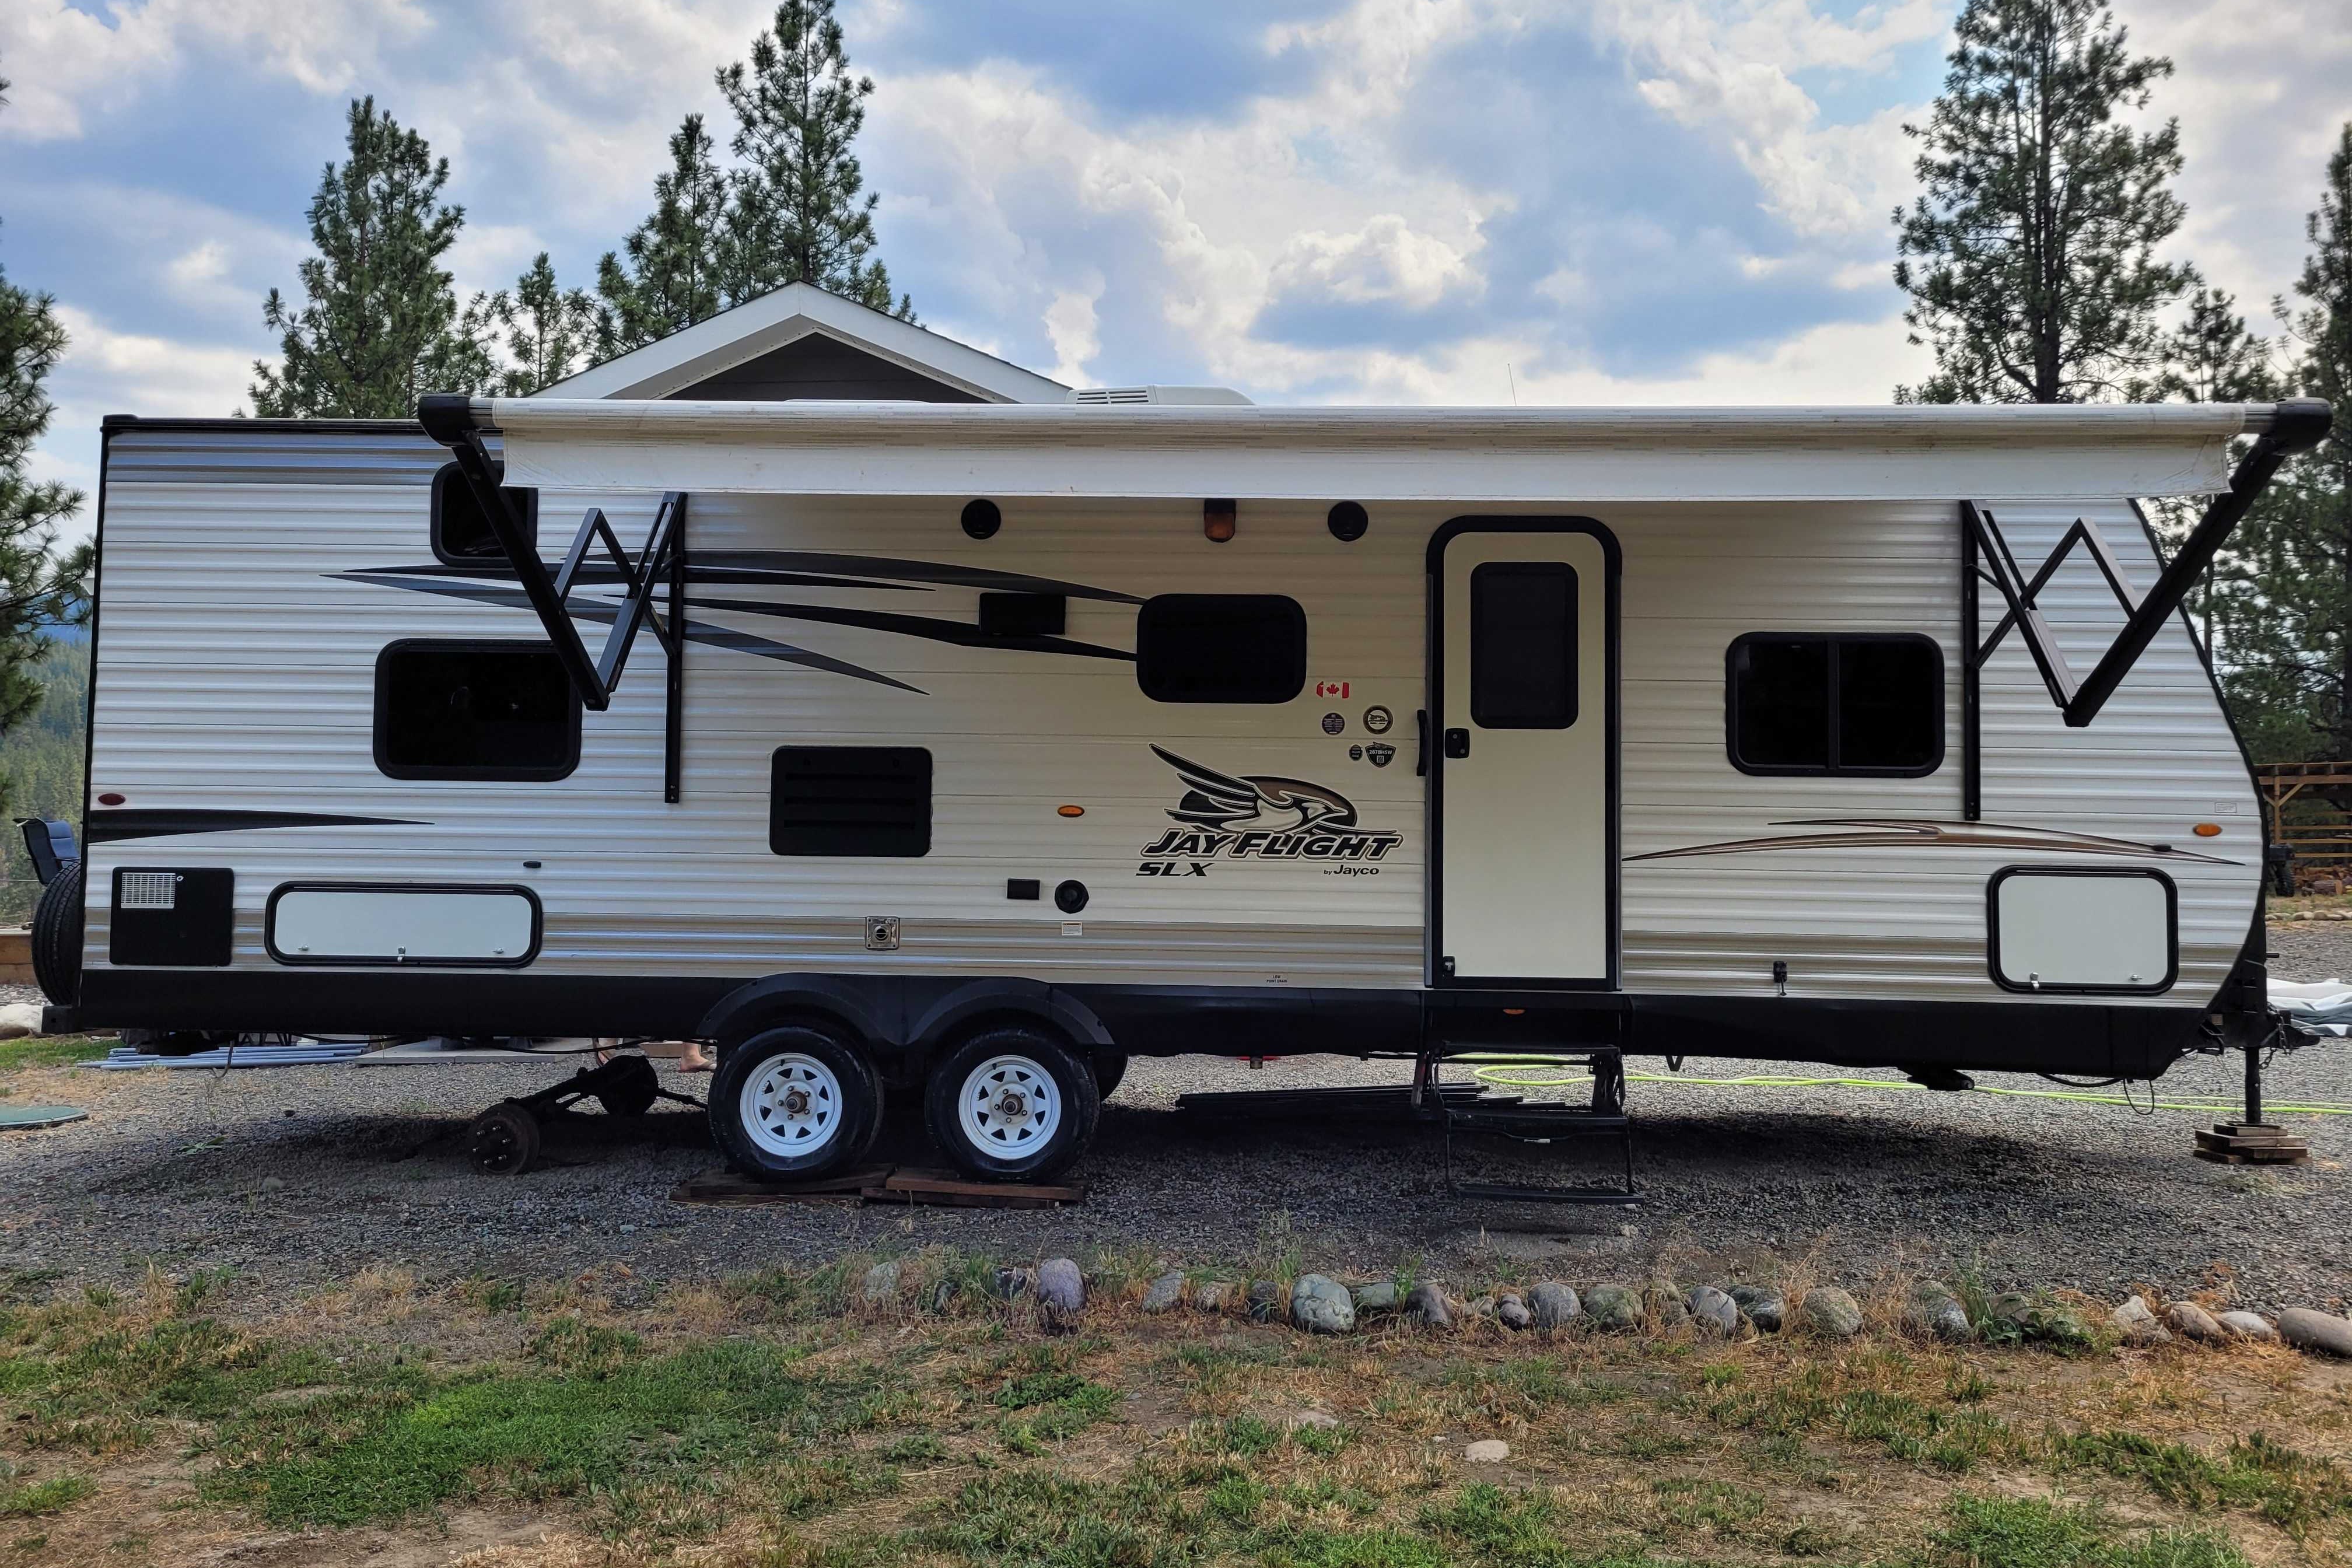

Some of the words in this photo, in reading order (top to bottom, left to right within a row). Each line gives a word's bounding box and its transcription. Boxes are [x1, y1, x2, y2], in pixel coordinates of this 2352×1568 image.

[1142, 830, 1236, 856] JAY
[1230, 831, 1402, 859] FLIGHT
[1135, 862, 1216, 877] SLX
[1333, 864, 1380, 877] Jayco
